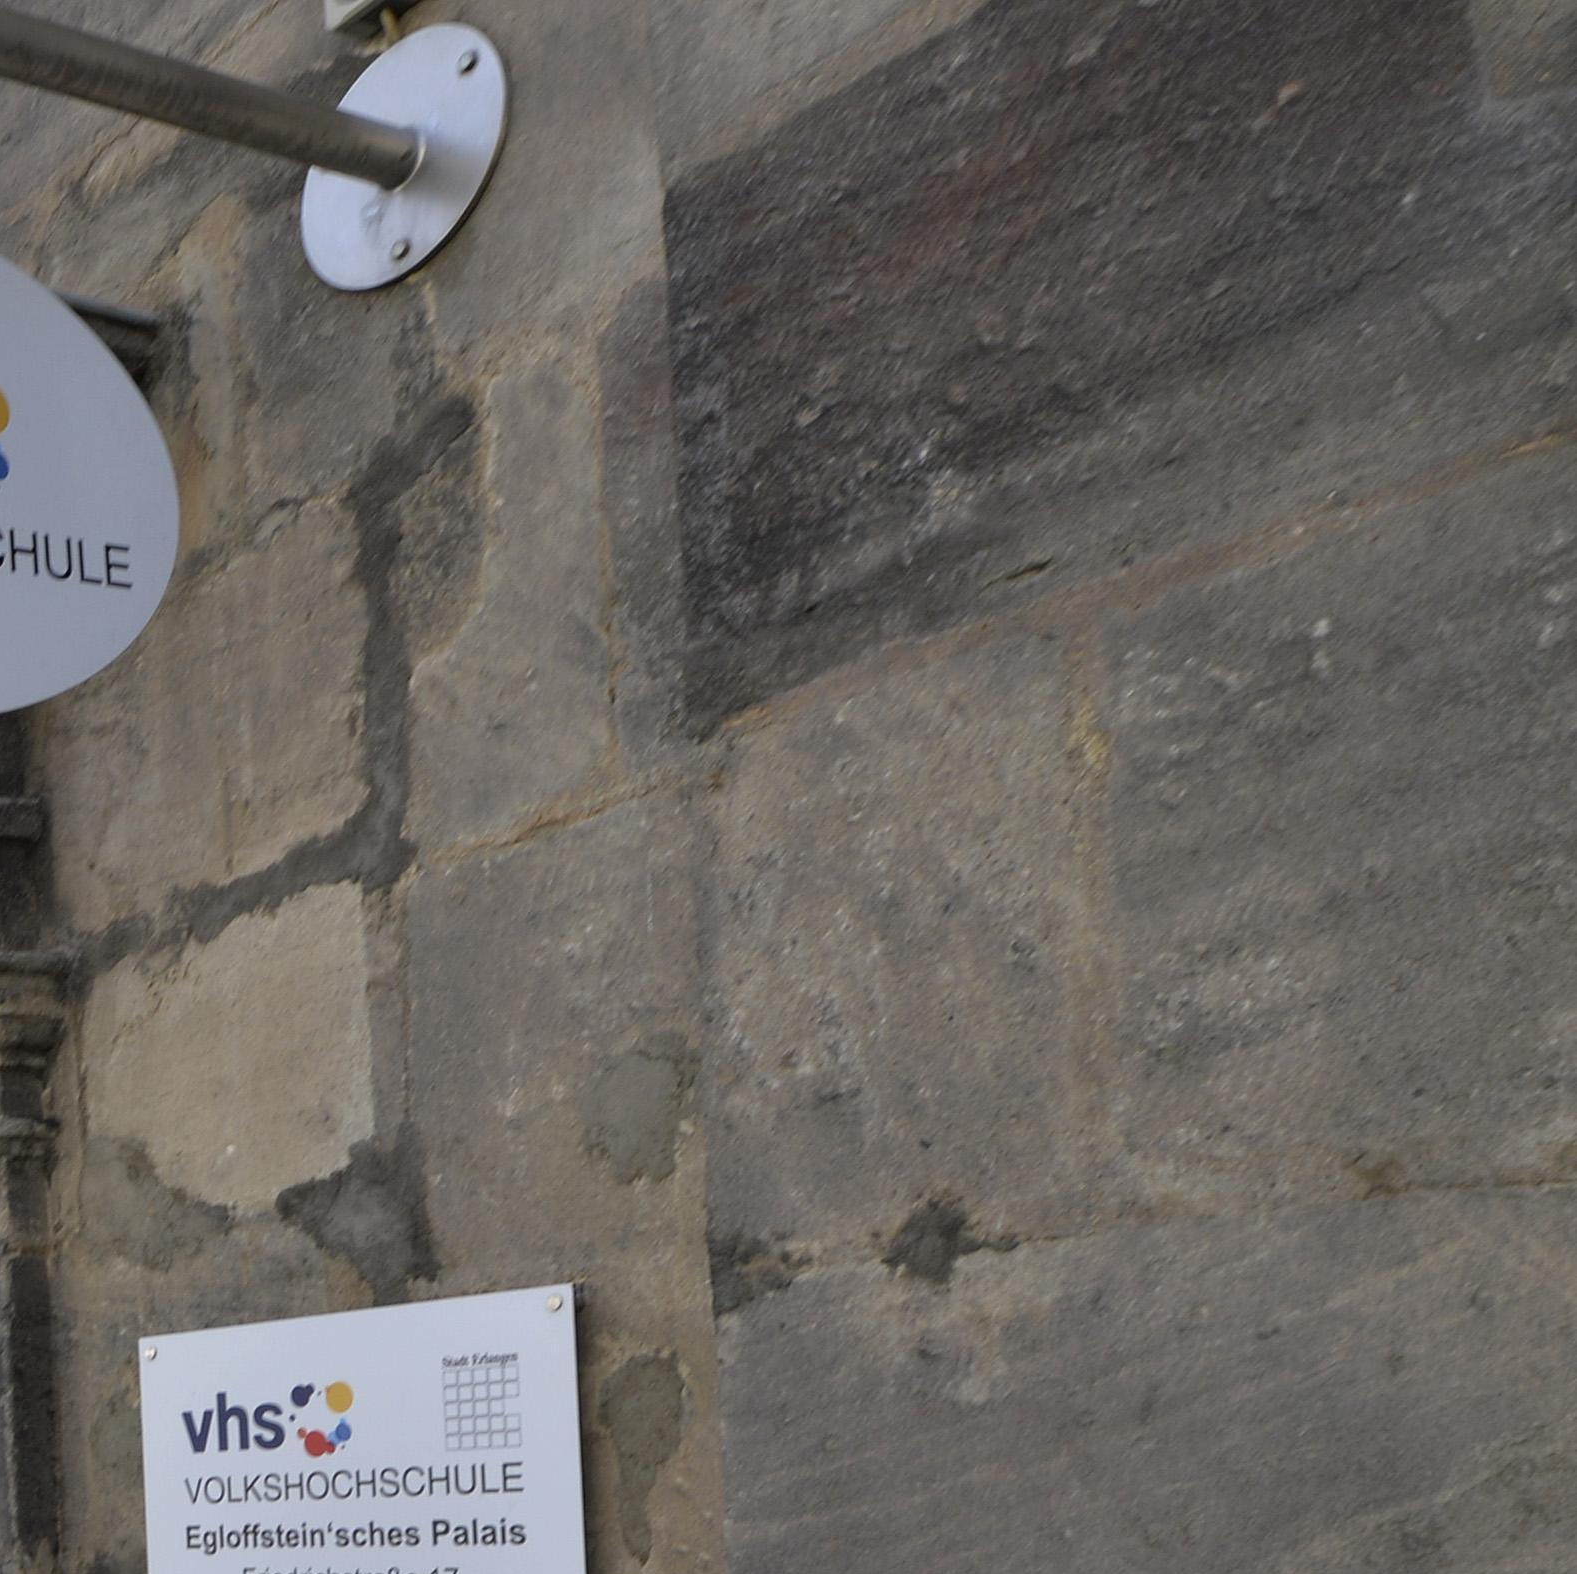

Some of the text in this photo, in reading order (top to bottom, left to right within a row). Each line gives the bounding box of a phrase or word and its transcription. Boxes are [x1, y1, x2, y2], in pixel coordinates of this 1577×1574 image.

[182, 1392, 285, 1453] vhs
[185, 1462, 524, 1504] VOLKSHOCHSCHULE
[431, 1517, 527, 1546] Palais
